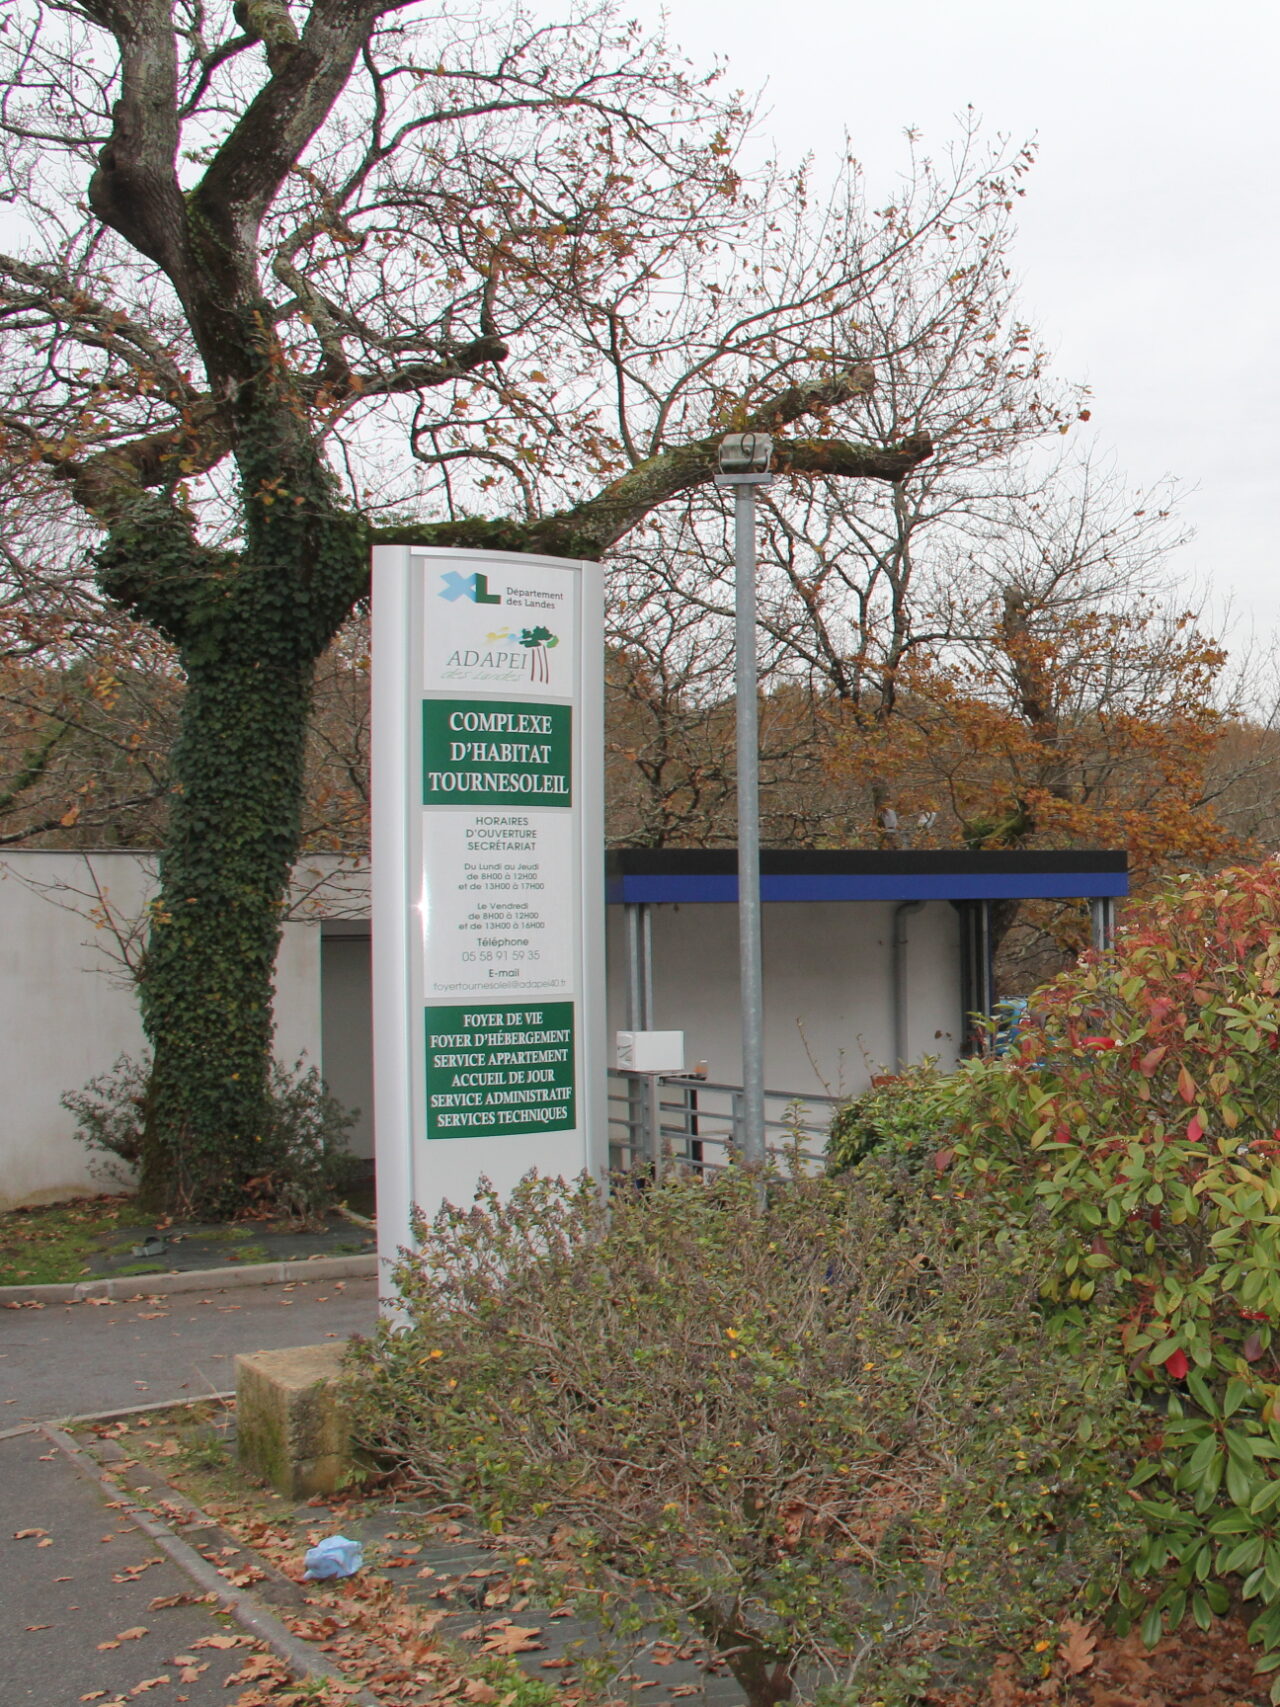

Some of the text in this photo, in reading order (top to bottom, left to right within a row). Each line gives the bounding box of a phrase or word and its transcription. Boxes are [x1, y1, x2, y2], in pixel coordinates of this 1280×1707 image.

[507, 587, 563, 600] Département
[507, 598, 555, 609] des Landes
[447, 650, 528, 669] ADAPEI
[449, 712, 552, 734] COMPLEXE
[450, 742, 551, 763] D'HABITAT
[429, 772, 569, 794] TOURNESOLEIL
[476, 817, 528, 826] HORAIRES
[466, 830, 537, 838] D'OUVERTURE
[468, 840, 536, 851] SECRÉTARIAT
[477, 938, 529, 947] Téléphone
[462, 950, 540, 962] 05 58 91 59 35
[489, 969, 519, 978] E-mail
[464, 1012, 543, 1027] FOYER DE VIE
[431, 1034, 472, 1048] FOYER
[434, 1049, 568, 1068] SERVICE APPARTEMENT
[452, 1069, 554, 1087] ACCUEIL DE JOUR
[431, 1087, 572, 1107] SERVICE ADMINISTRATIF
[438, 1107, 568, 1127] SERVICES TECHNIQUES
